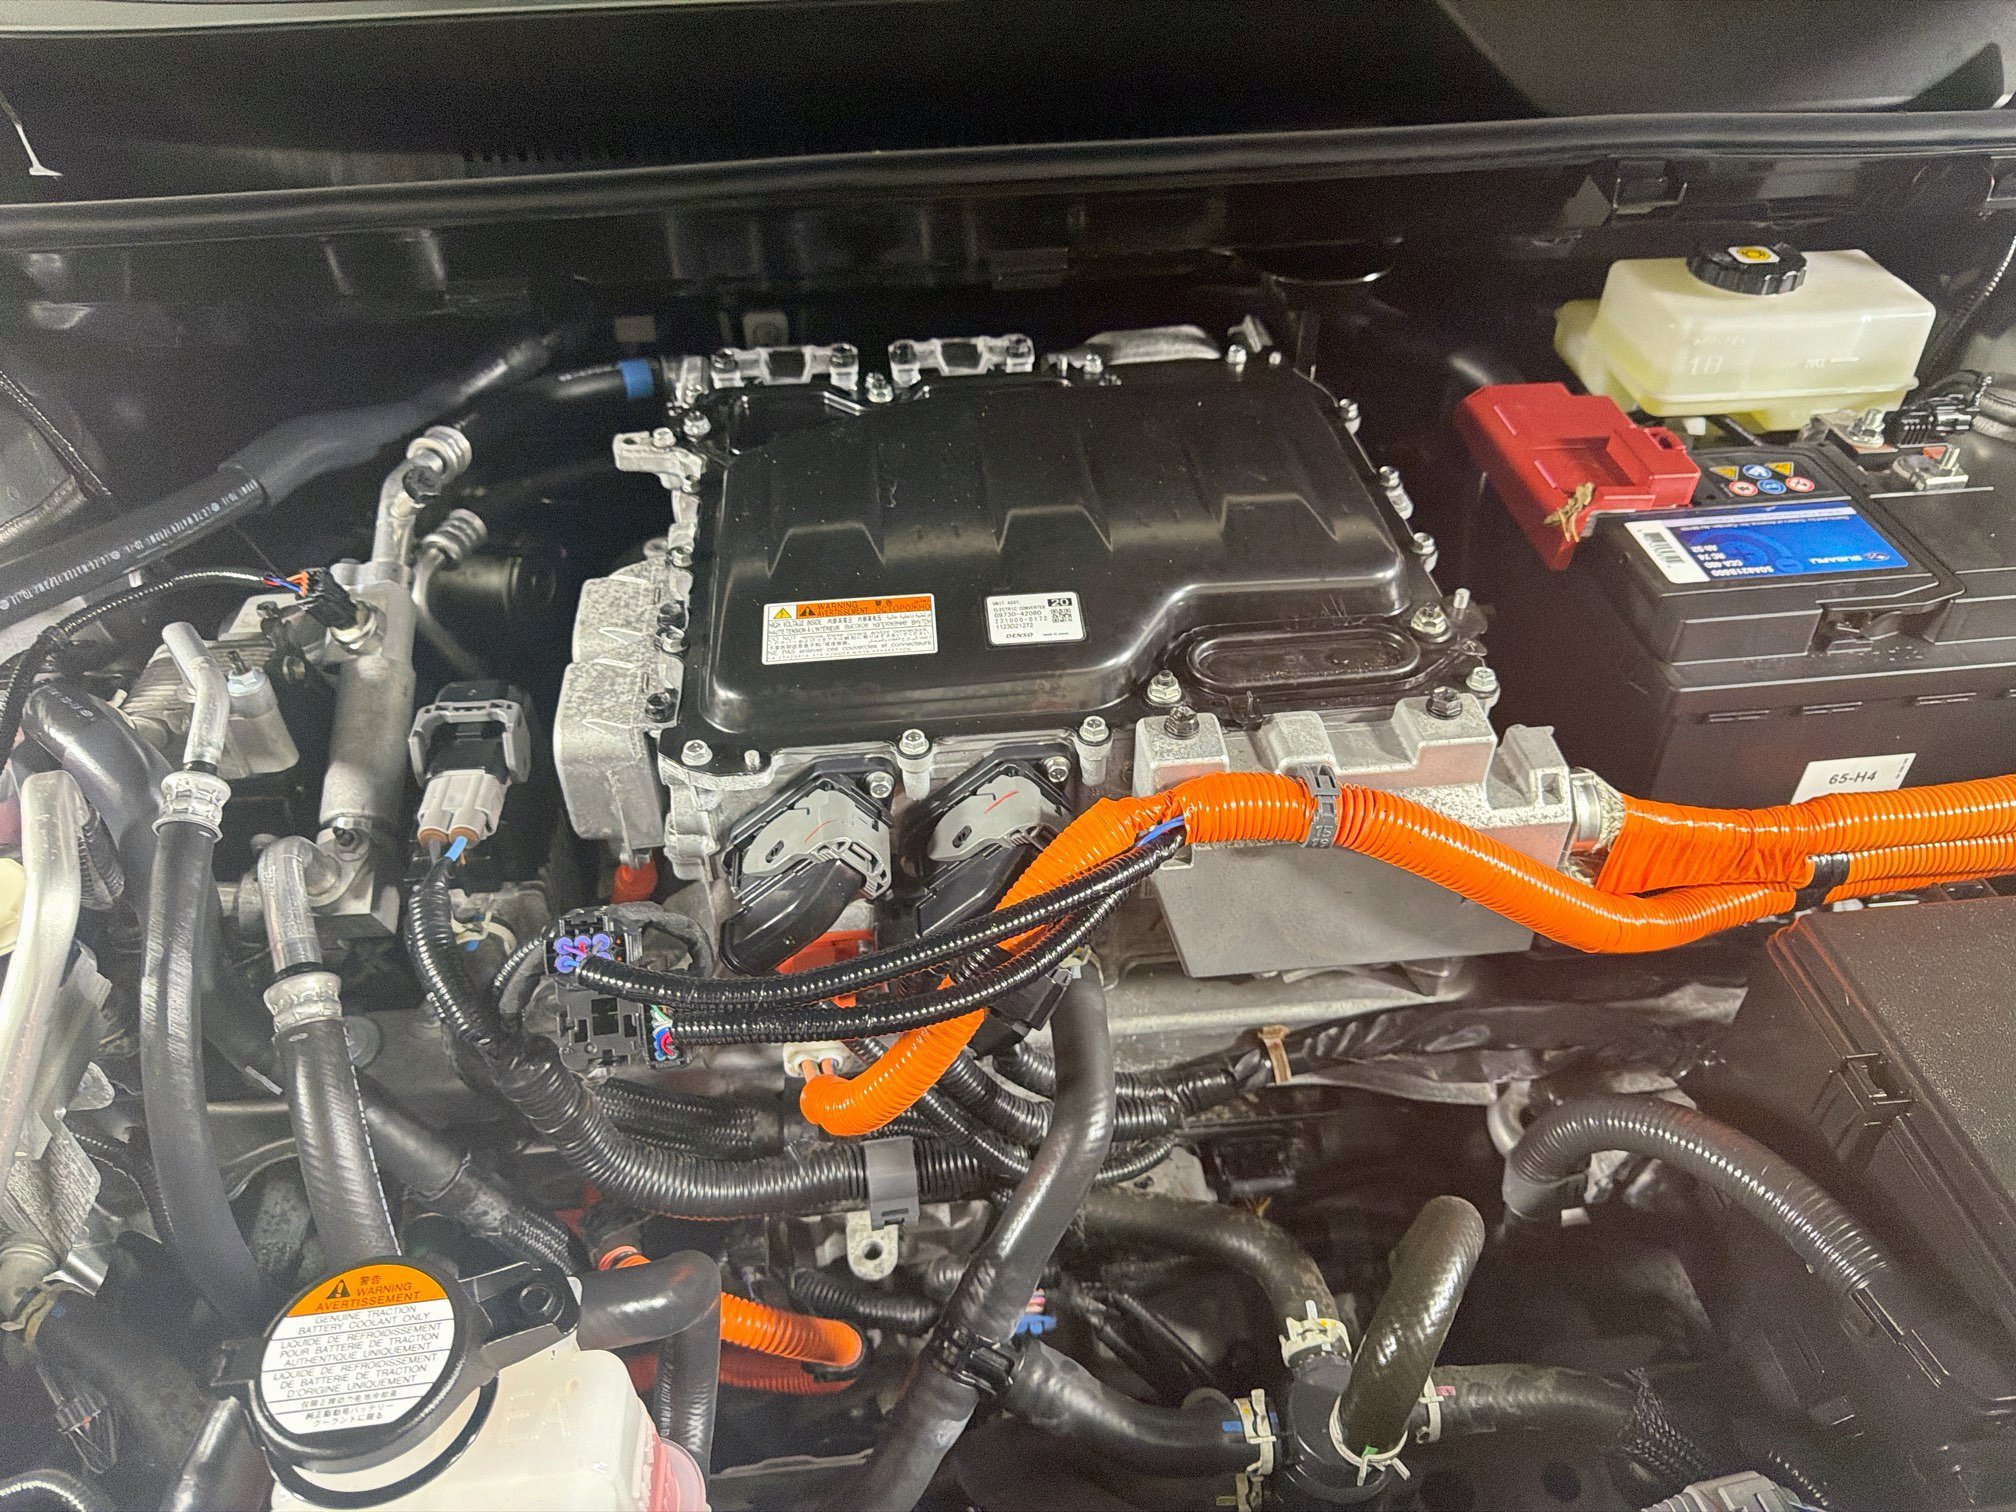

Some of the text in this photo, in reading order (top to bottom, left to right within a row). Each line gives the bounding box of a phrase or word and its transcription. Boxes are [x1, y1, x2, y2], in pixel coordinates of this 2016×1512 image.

[1808, 554, 1863, 565] SUBARU
[818, 601, 858, 610] WARNING
[1828, 770, 1878, 785] 65-H4
[357, 1281, 412, 1297] WARNING
[360, 1275, 382, 1286] 警告
[316, 1291, 421, 1311] AVERTISSEMENT
[298, 1311, 431, 1335] BATTERY COOLANT ONLY
[315, 1305, 417, 1324] GENUINE TRACTION
[280, 1331, 440, 1359] POUR BATTERIE DE TRACTION
[281, 1322, 442, 1349] LIQUIDE DE REFROIDISSEMENT
[283, 1341, 432, 1367] AUTHENTIQUE UNIQUEMENT
[273, 1353, 437, 1381] LIQUIDE DE REFROIDISSEMENT
[280, 1364, 427, 1389] DE BATTERIE DE TRACTION
[287, 1374, 417, 1398] D'ORIGINE UNIQUEMENT
